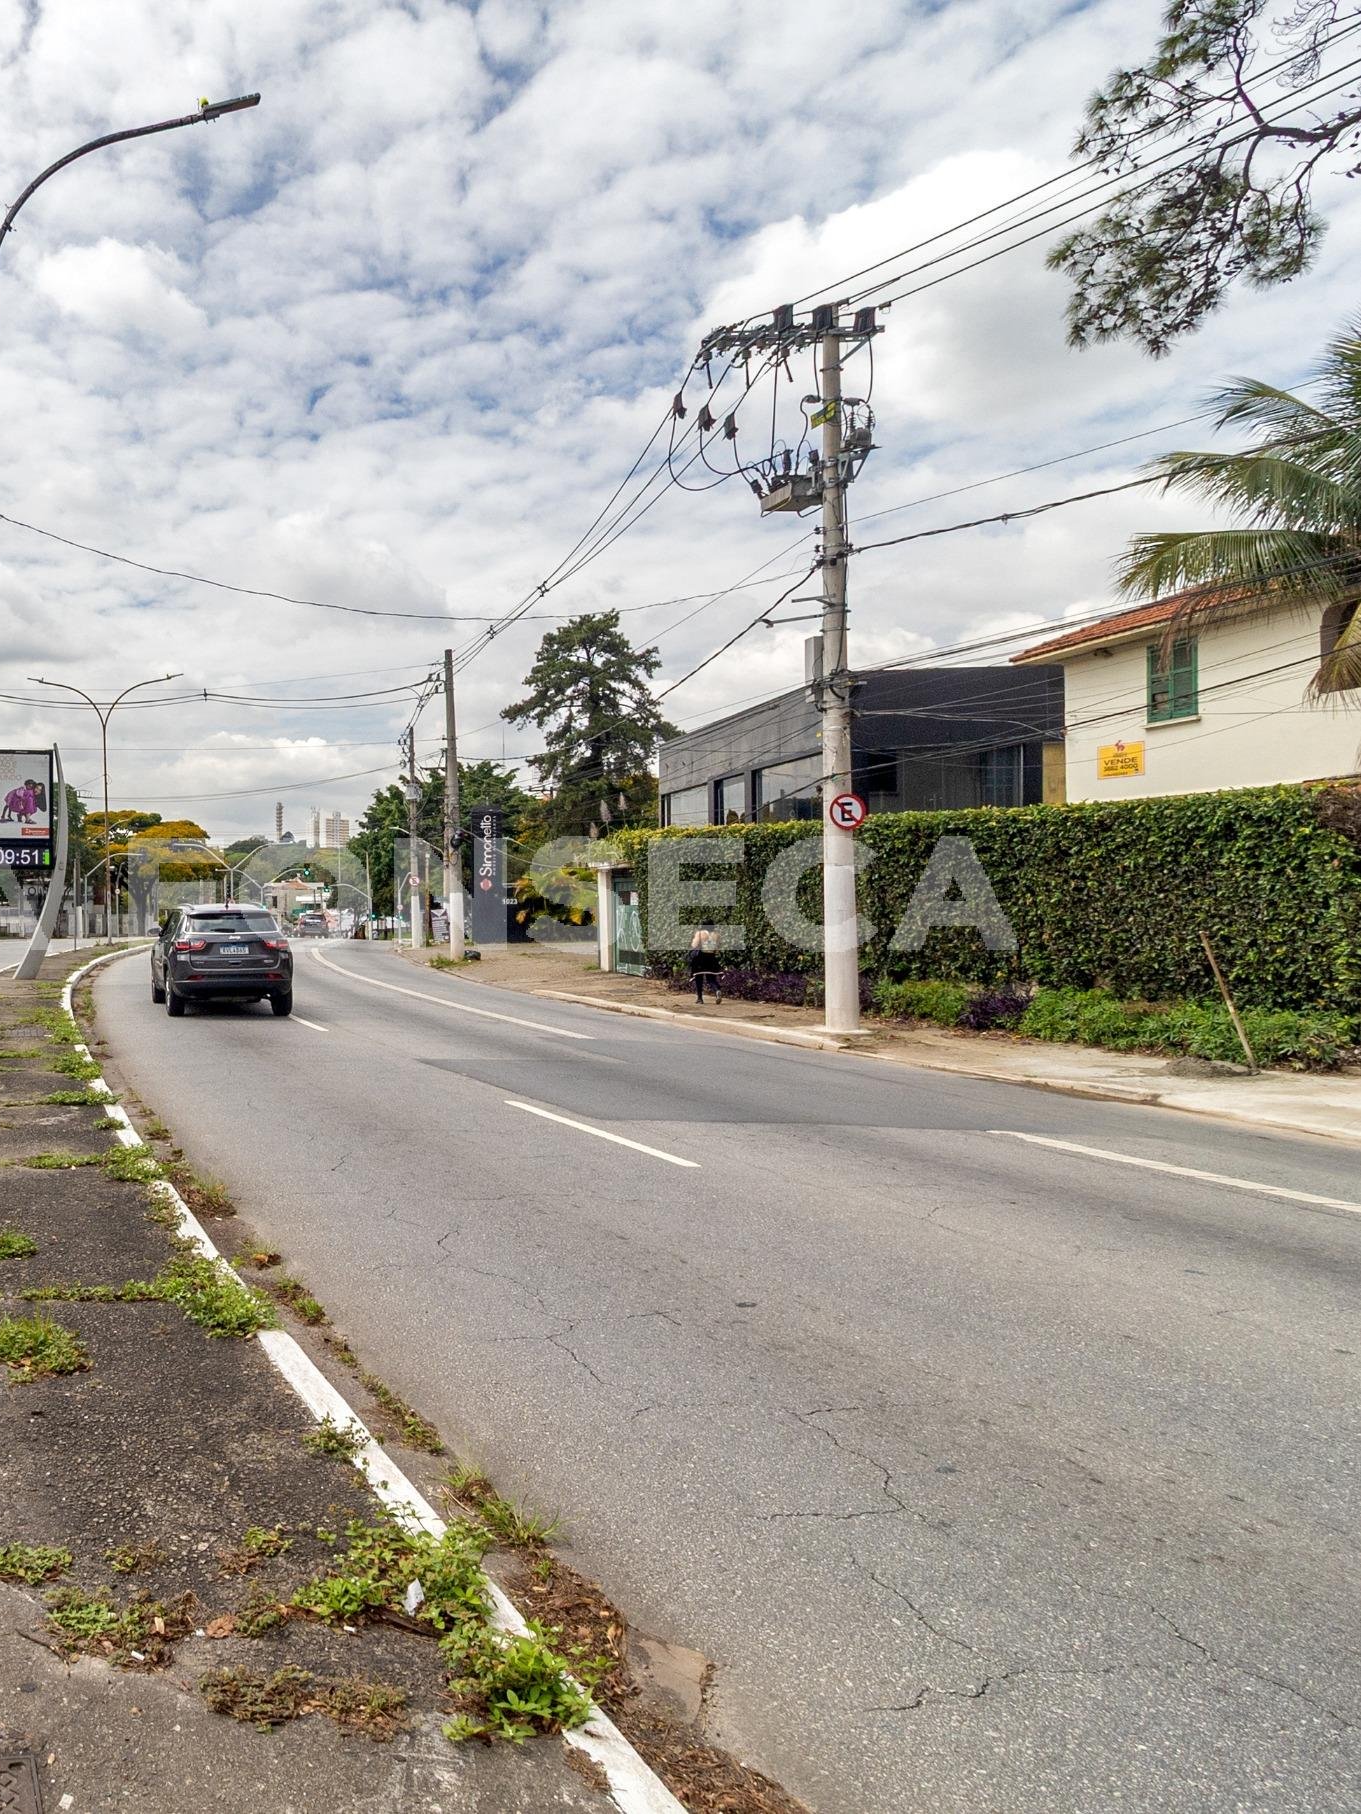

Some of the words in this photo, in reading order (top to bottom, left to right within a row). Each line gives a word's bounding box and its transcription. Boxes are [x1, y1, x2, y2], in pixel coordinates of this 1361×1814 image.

[1104, 757, 1138, 766] VENDE
[841, 802, 855, 821] E
[479, 815, 493, 877] Simonetto
